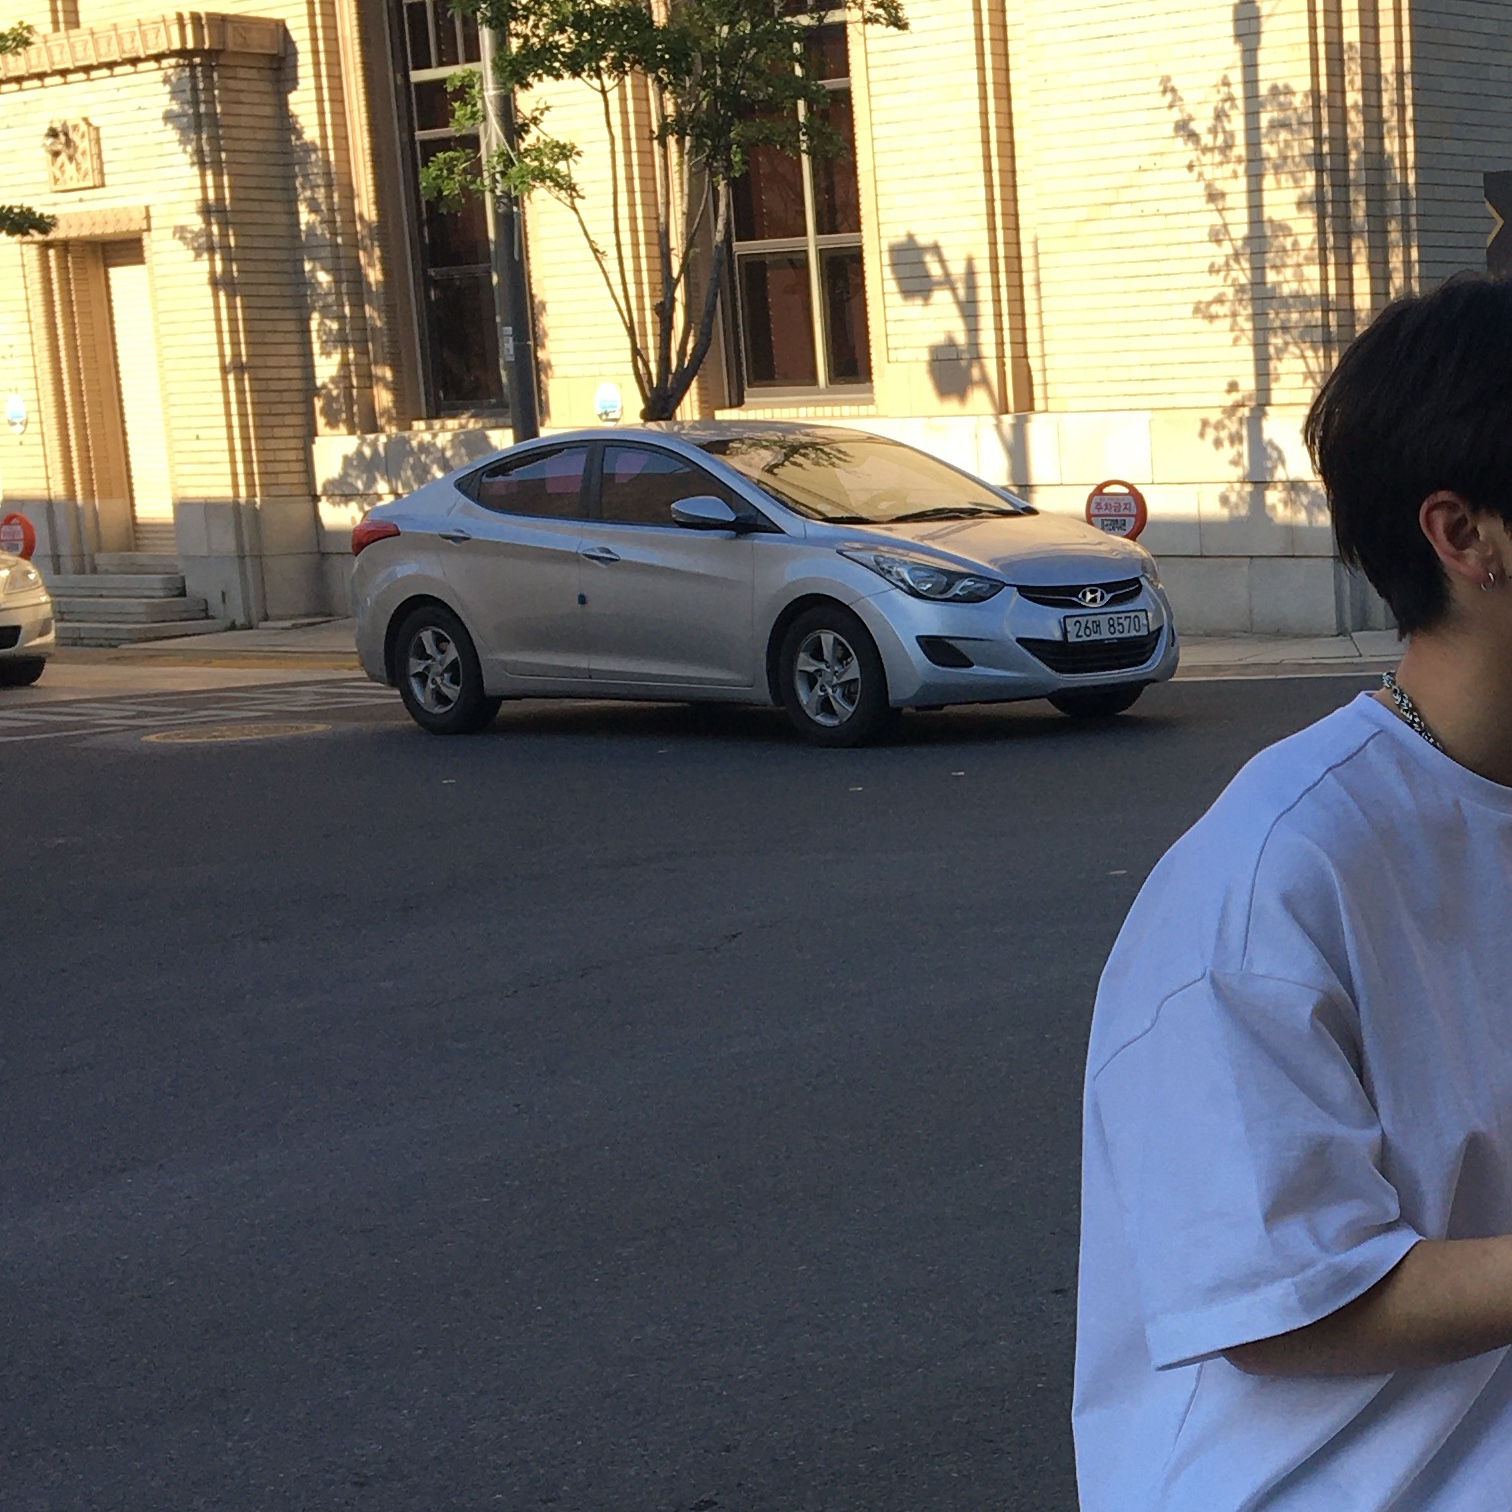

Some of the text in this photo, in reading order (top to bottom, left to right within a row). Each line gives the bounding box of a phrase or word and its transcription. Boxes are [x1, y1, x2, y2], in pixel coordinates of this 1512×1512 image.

[1095, 502, 1131, 513] 주차금지
[1074, 615, 1141, 639] 26머 8570
